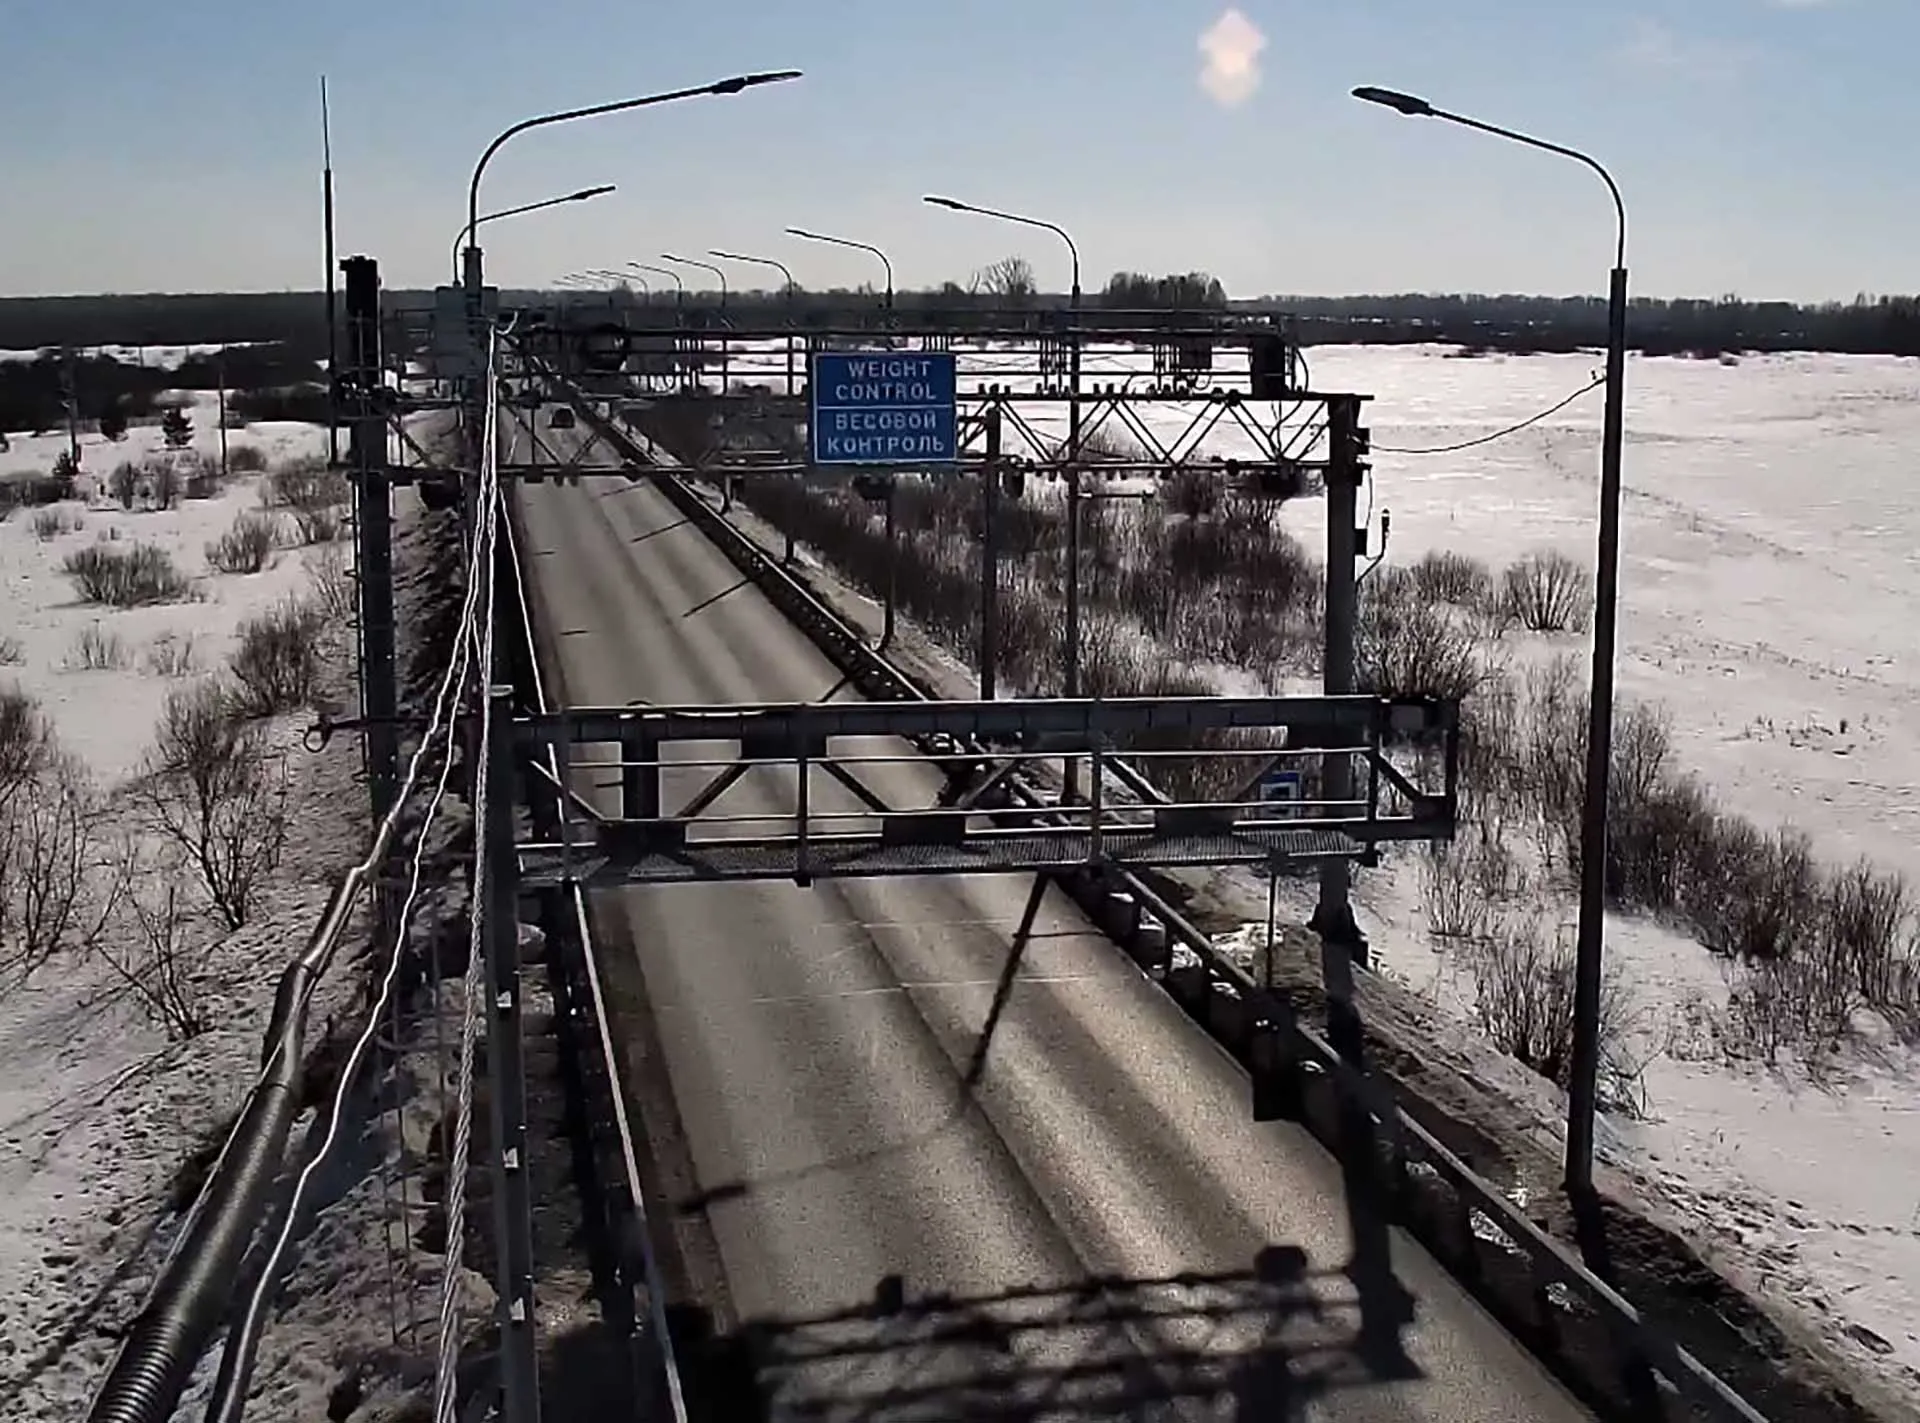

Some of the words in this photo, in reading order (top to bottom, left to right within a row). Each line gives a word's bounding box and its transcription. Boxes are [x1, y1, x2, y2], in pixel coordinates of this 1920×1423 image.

[848, 361, 931, 377] WEIGHT
[836, 383, 936, 400] CONTROL
[835, 411, 936, 430] ВЕСОВОЙ
[827, 436, 944, 454] КОНТРОЛЬ
